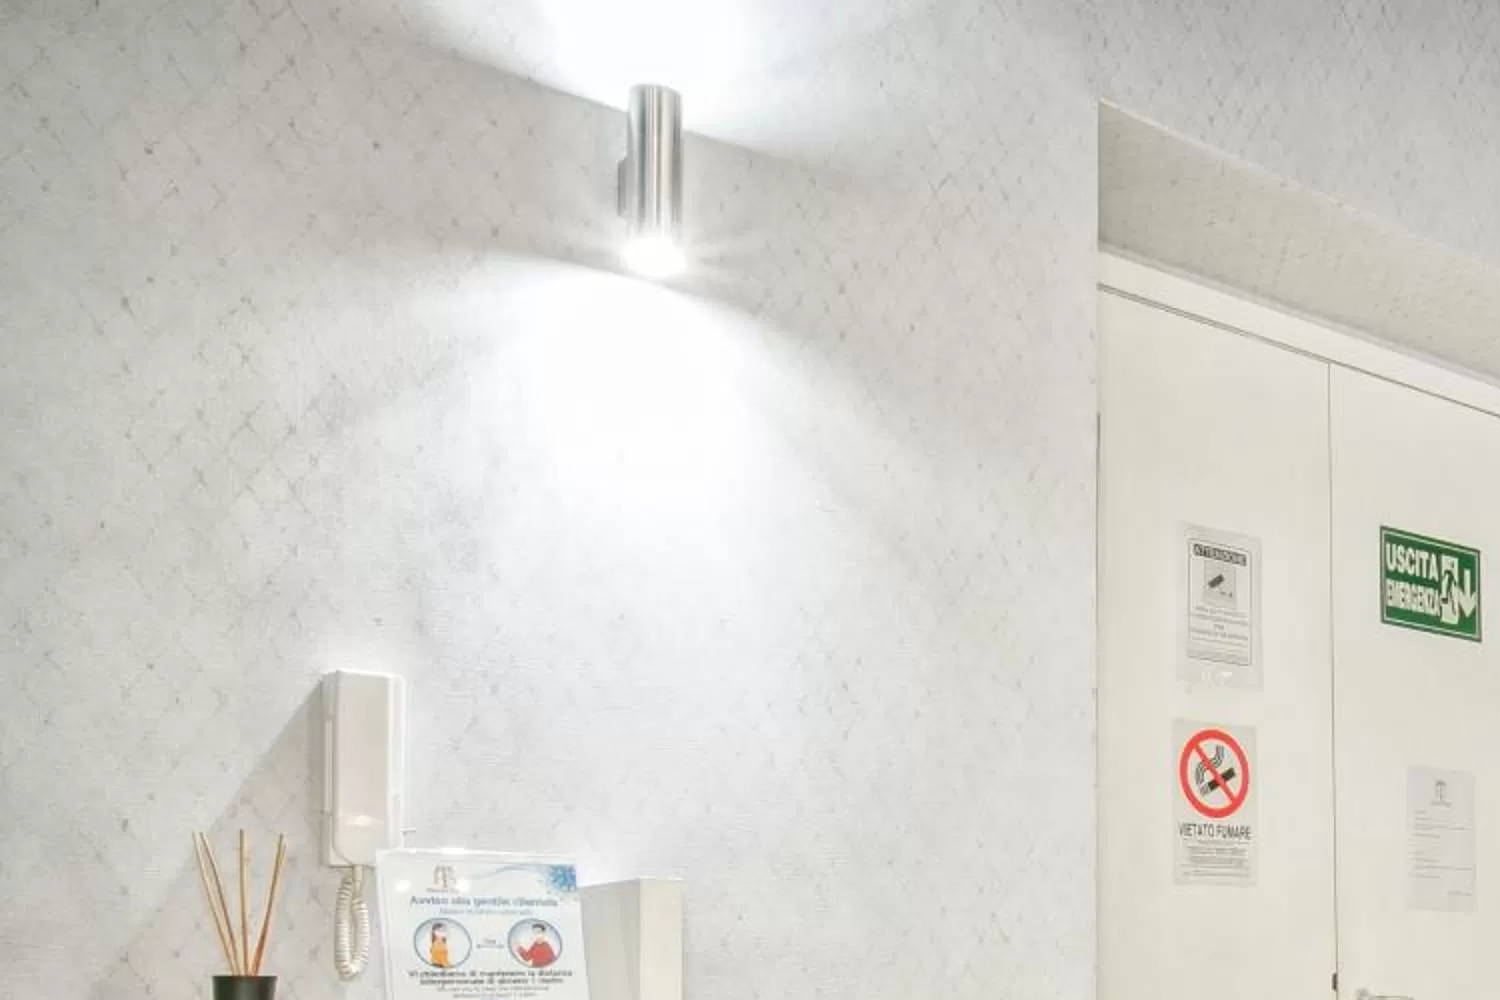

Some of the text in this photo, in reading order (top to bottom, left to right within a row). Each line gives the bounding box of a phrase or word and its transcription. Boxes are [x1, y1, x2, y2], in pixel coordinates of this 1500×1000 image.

[1385, 542, 1438, 582] USCITA
[1386, 579, 1441, 617] EMERGENZA
[1178, 822, 1252, 841] VIETATO FUMARE
